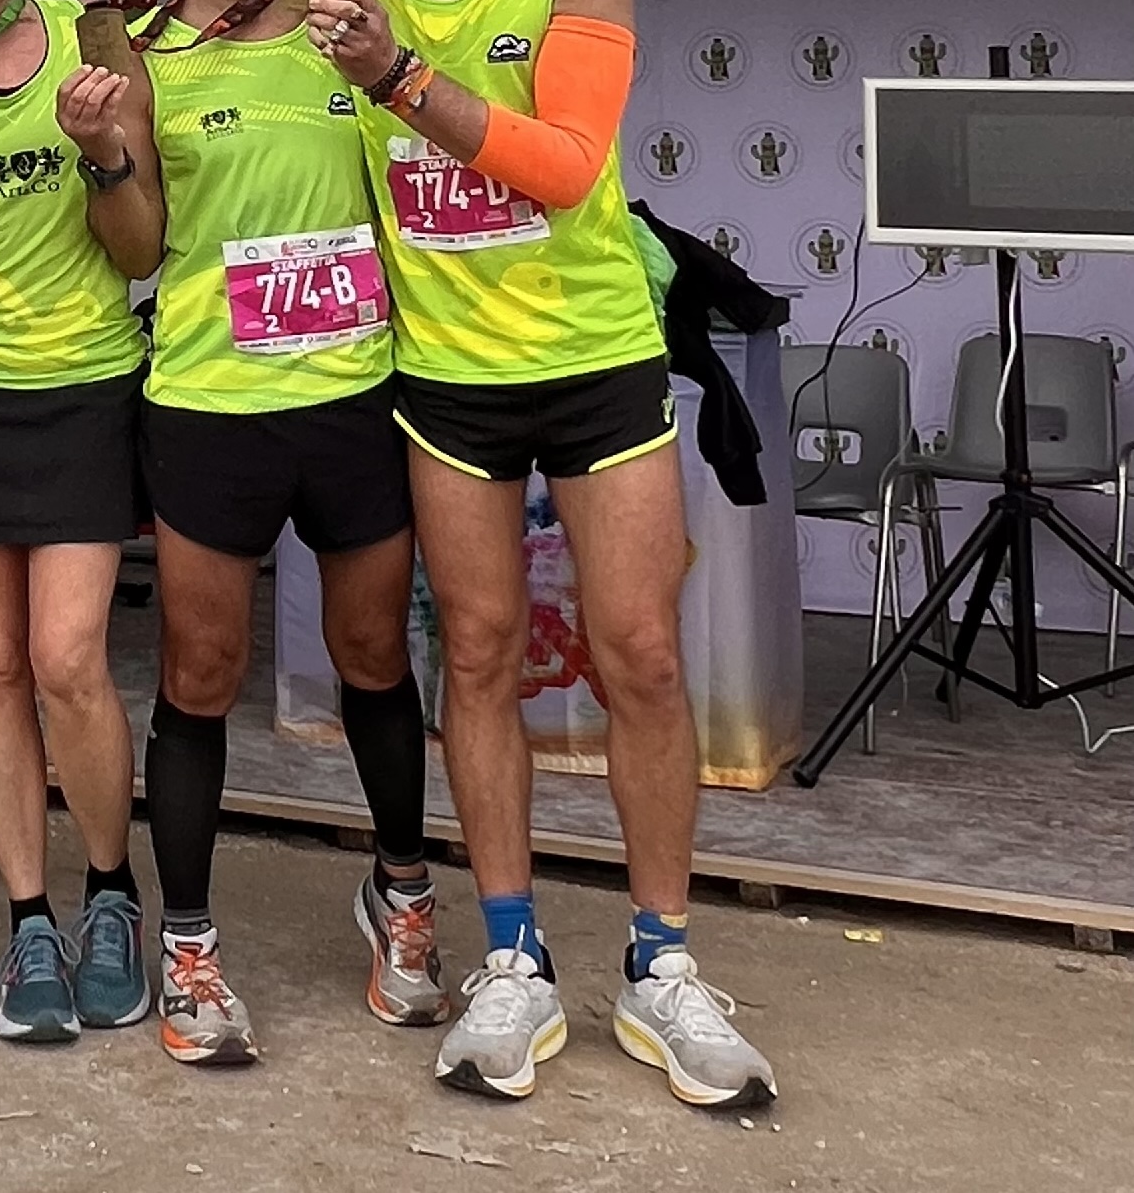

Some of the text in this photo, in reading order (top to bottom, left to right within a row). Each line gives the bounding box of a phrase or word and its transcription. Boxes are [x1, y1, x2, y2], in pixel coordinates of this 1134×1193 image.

[420, 211, 436, 229] 2
[270, 254, 338, 273] STAFFETTA
[256, 264, 357, 313] 774-B
[265, 314, 282, 334] 2
